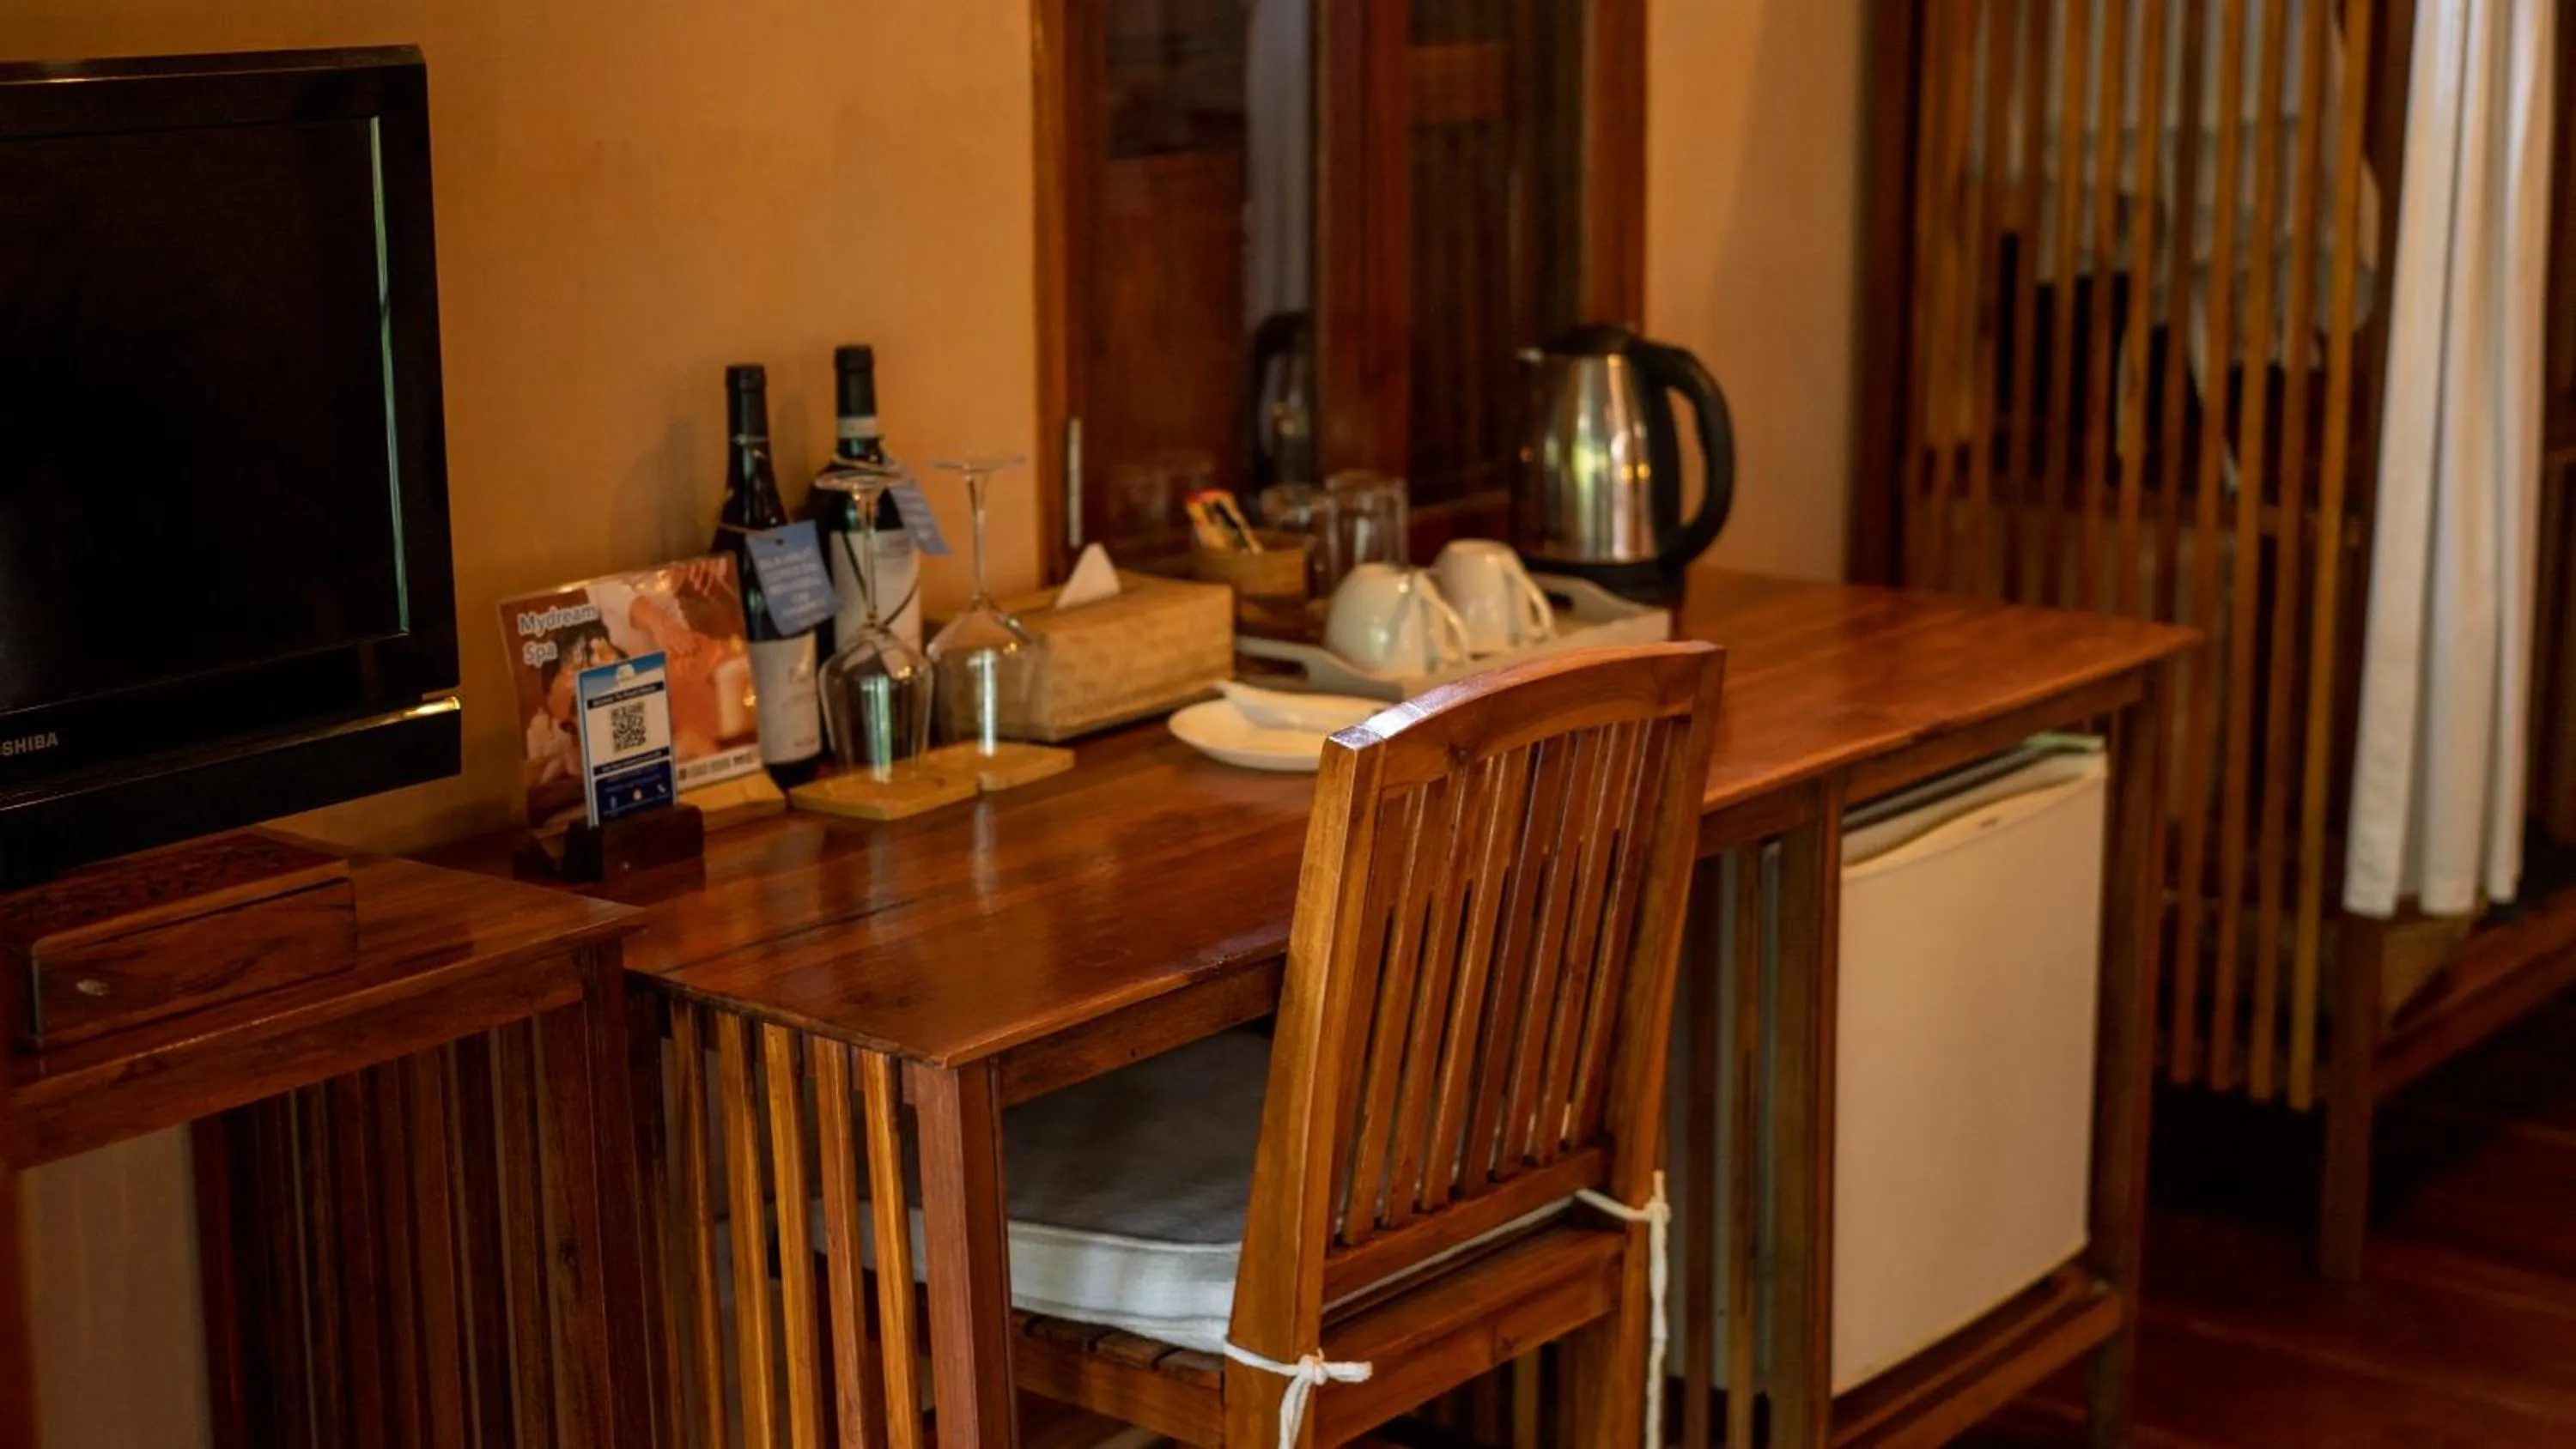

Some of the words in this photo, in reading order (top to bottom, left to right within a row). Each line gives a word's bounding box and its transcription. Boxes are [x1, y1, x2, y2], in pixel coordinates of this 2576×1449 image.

[518, 606, 598, 636] Mydream
[523, 641, 557, 668] Spa
[0, 732, 58, 755] SHIBA
